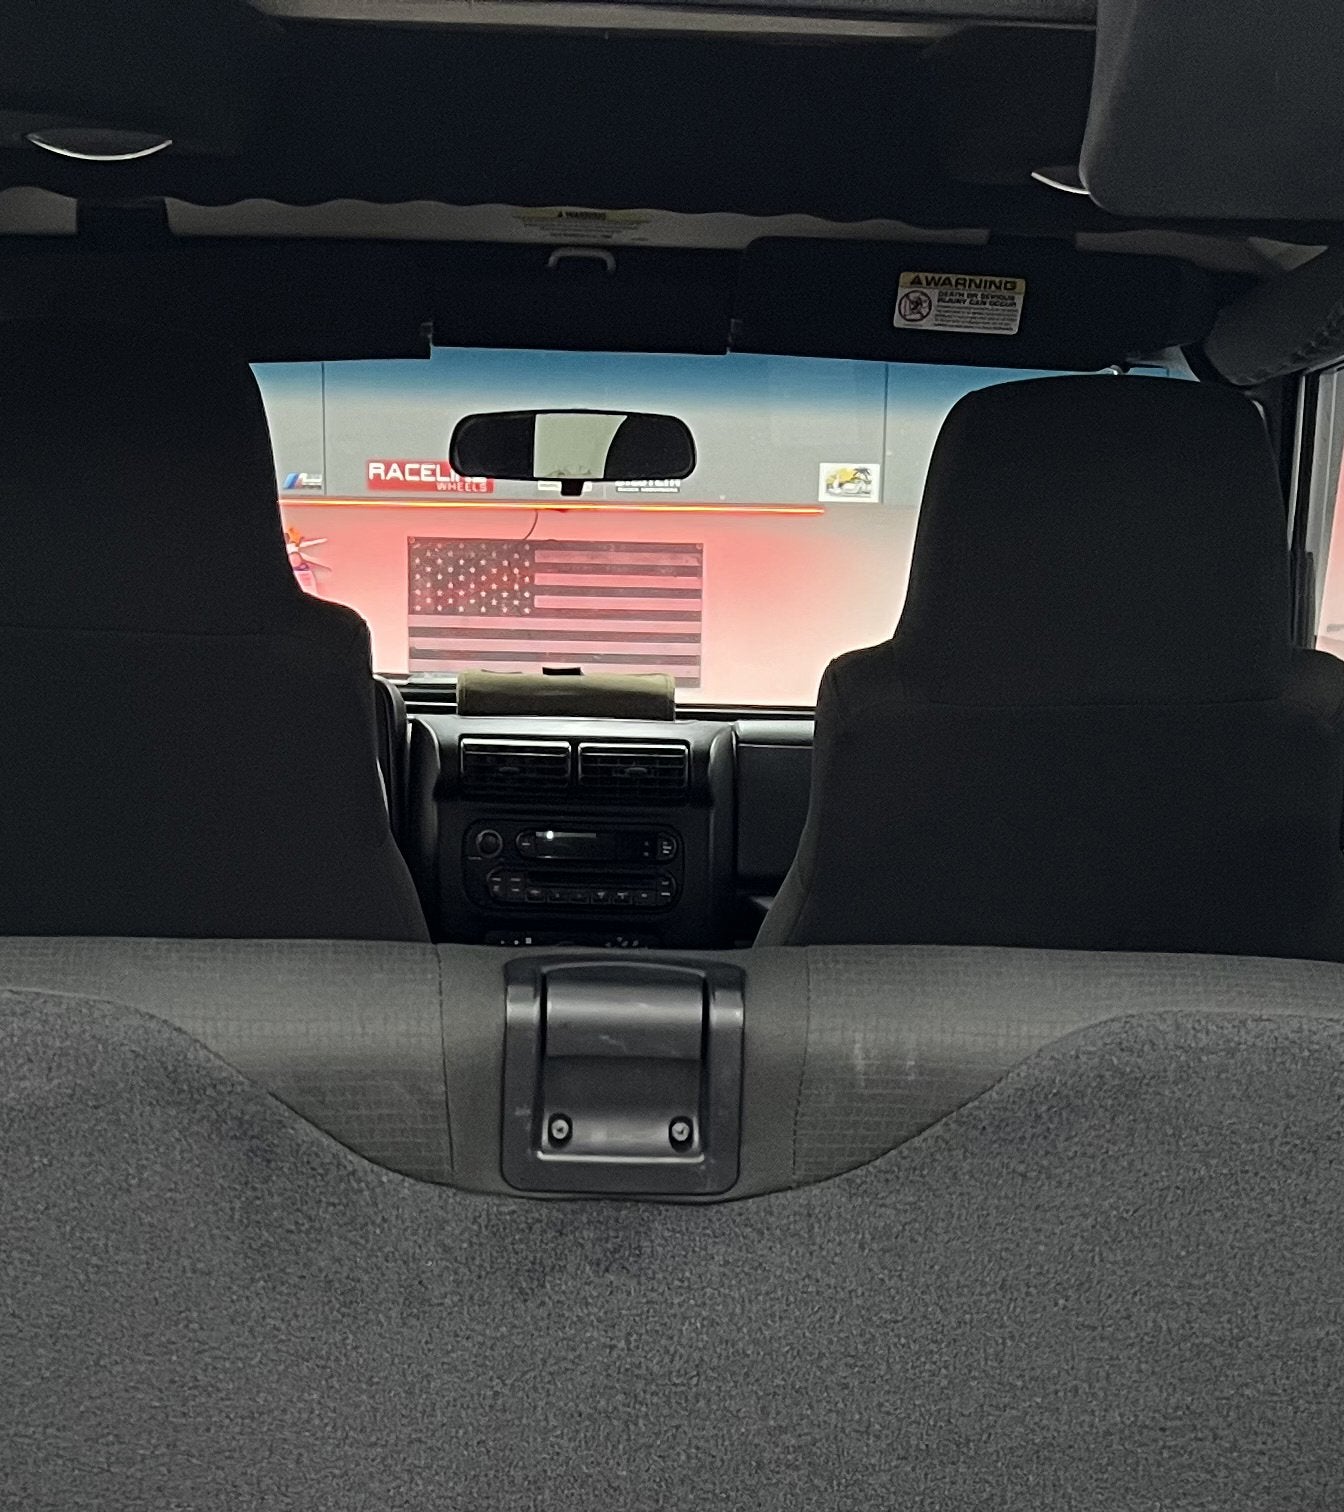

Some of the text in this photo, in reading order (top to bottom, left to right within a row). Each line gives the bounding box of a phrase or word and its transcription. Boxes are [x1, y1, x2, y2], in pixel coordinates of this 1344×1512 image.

[925, 275, 1017, 291] WARNING
[368, 462, 487, 482] RACELI
[436, 482, 488, 492] WHEELS
